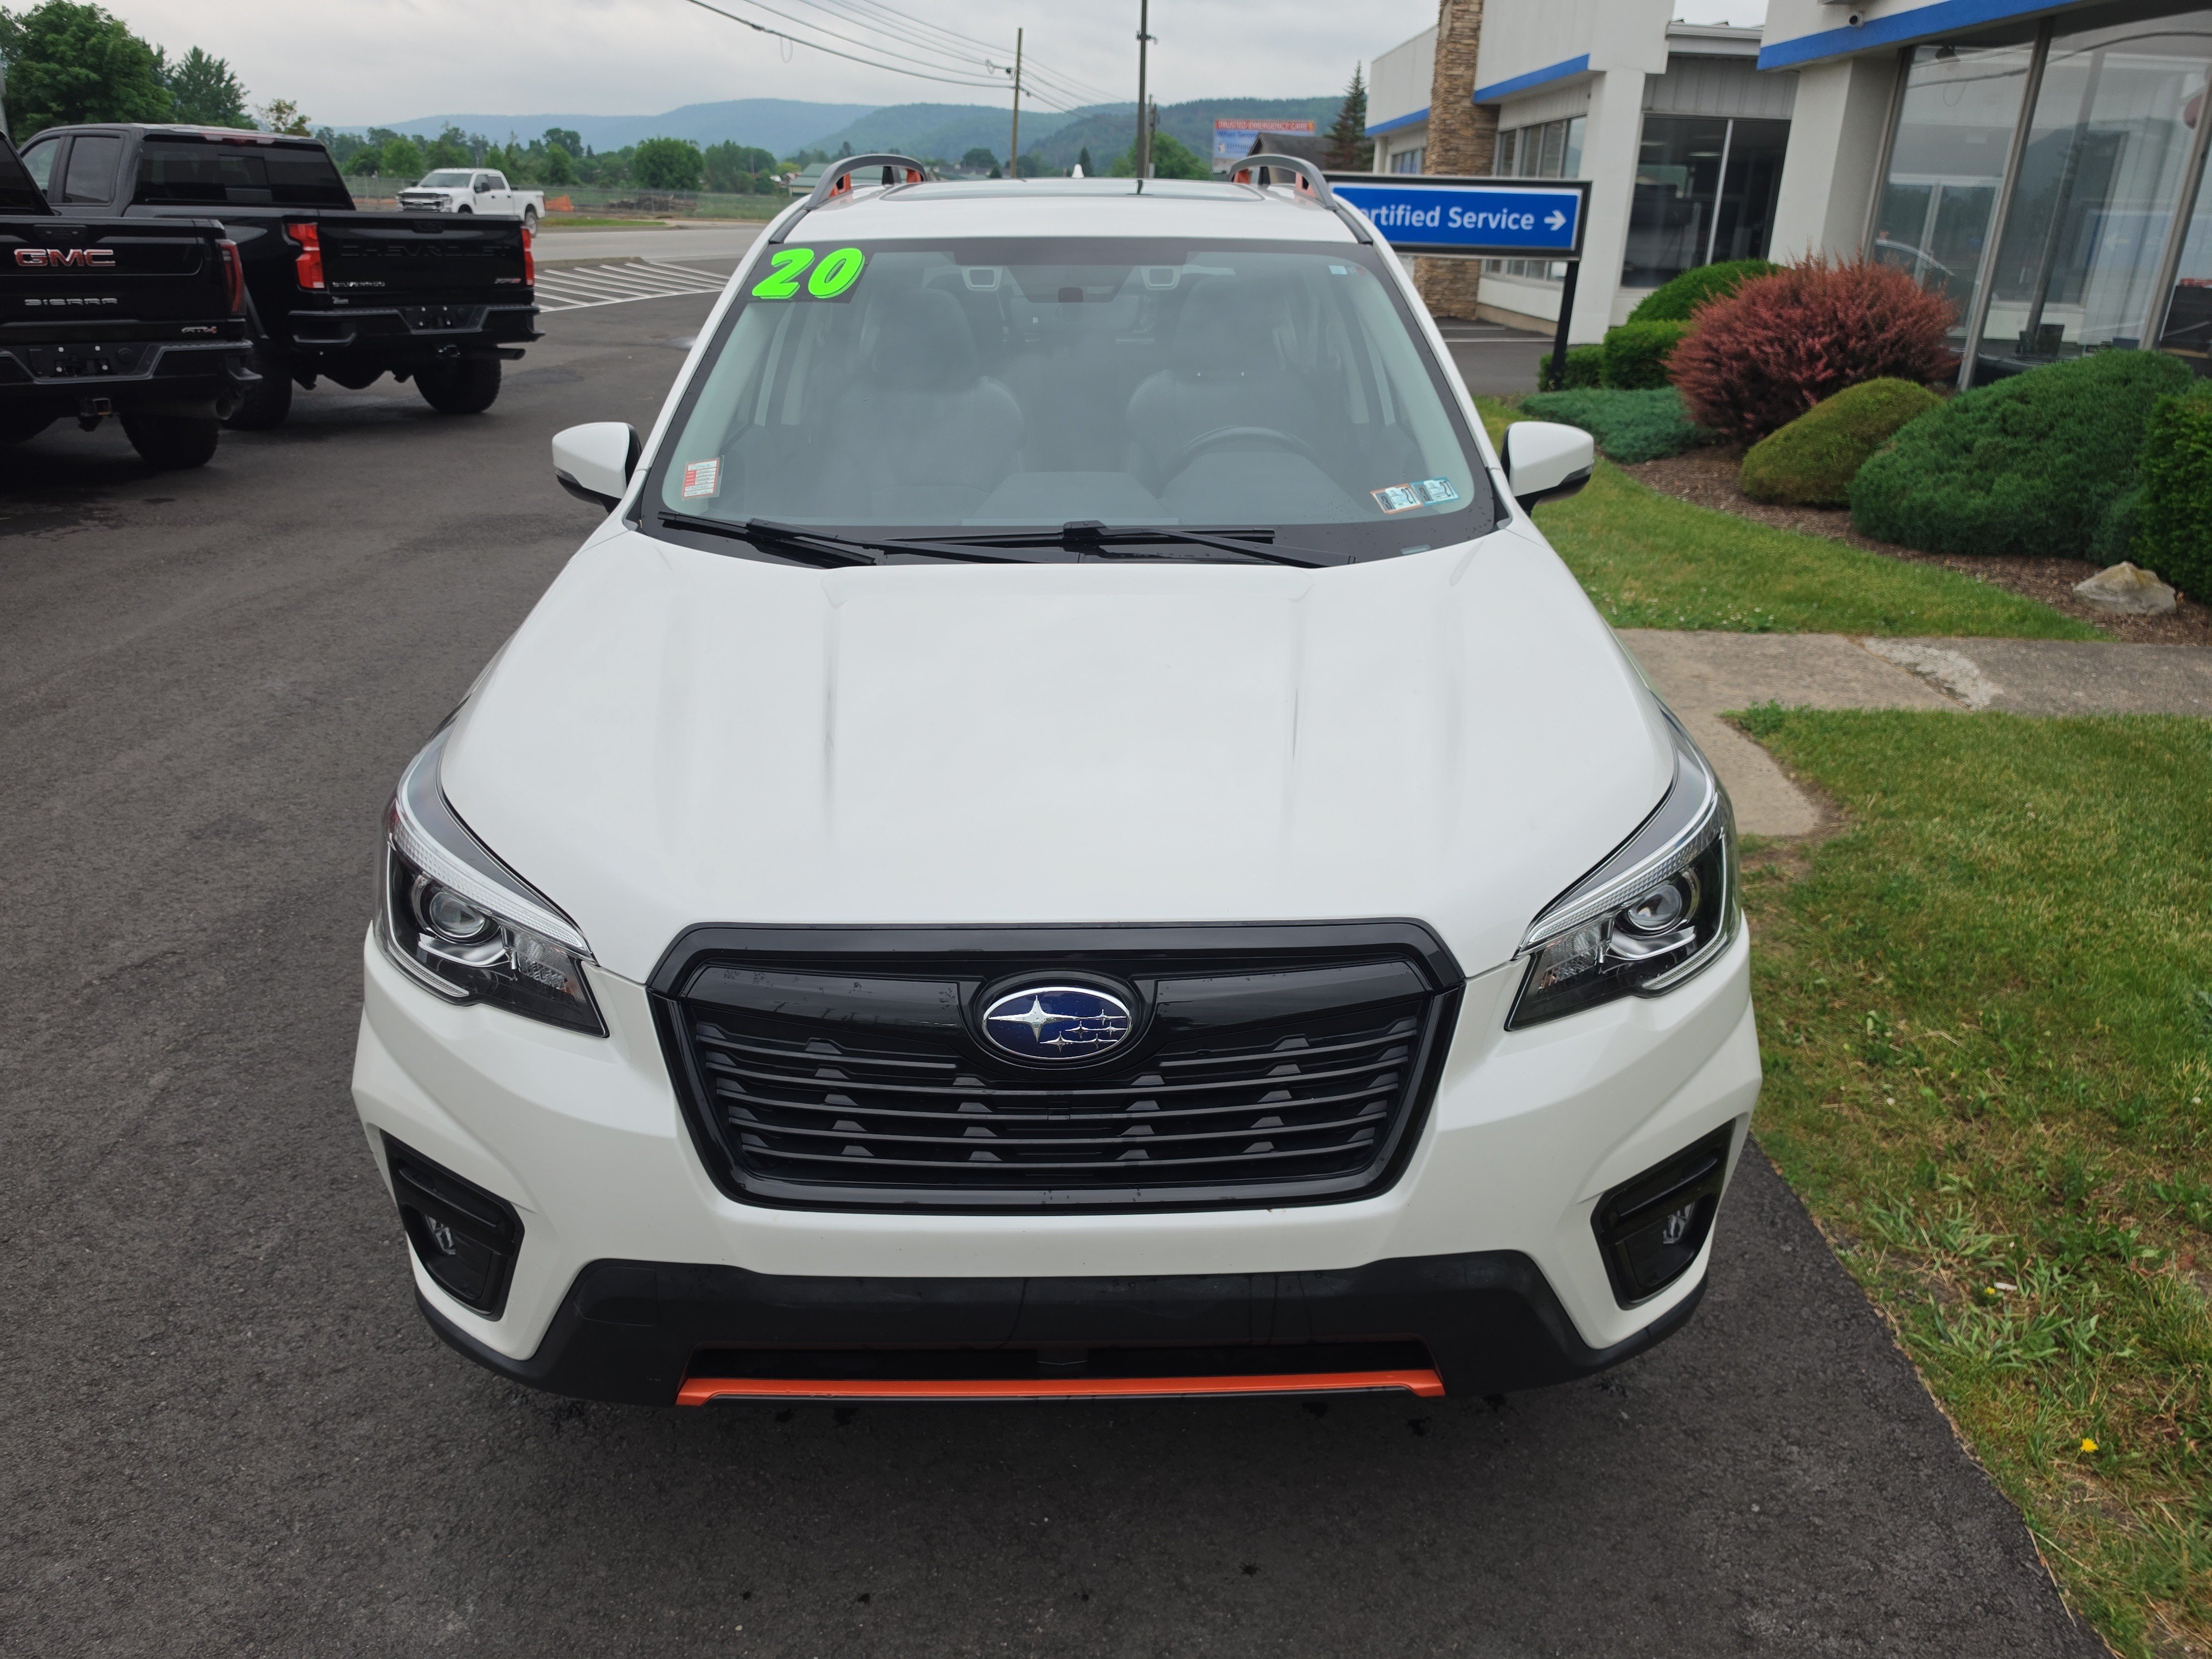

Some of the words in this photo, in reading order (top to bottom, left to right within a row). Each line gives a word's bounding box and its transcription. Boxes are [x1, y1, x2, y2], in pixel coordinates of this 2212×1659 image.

[1447, 206, 1535, 230] Service
[14, 248, 116, 267] GMC
[751, 247, 866, 299] 20
[24, 298, 118, 306] SIERRA
[1380, 496, 1393, 510] 3
[1401, 487, 1418, 505] 27
[1418, 487, 1431, 501] 3
[1439, 480, 1455, 498] 27
